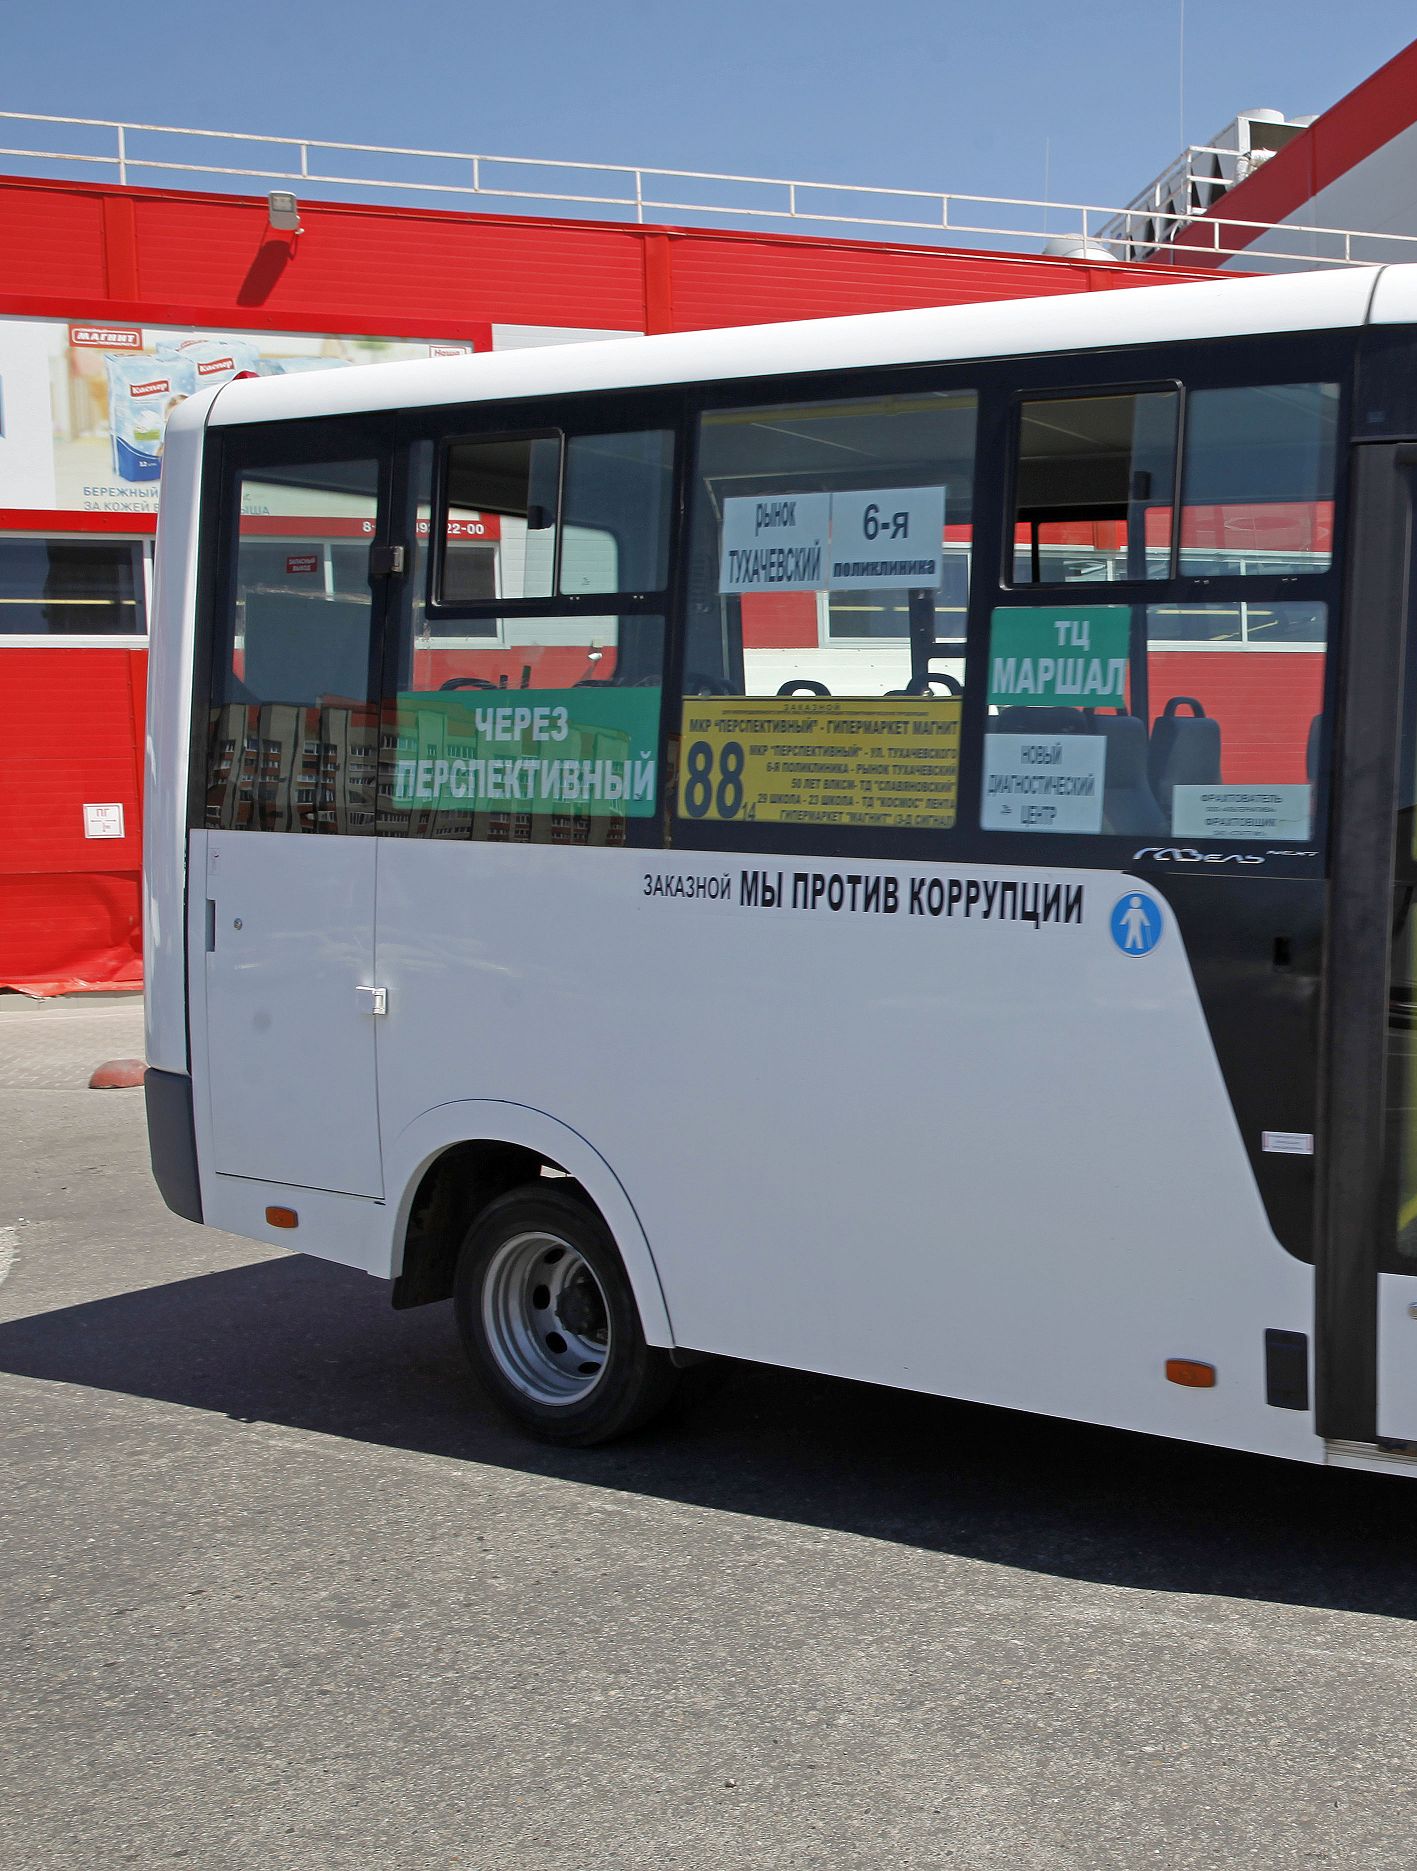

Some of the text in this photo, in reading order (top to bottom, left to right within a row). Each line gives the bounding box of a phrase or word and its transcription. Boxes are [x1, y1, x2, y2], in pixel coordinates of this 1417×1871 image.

[76, 331, 135, 344] МАГНИТ
[83, 486, 159, 498] БЕРЕЖНЫЙ
[84, 501, 101, 511] ЗА
[103, 502, 150, 513] КОЖЕЙ
[728, 540, 822, 583] ТУХАЧЕВСКИЙ
[833, 558, 936, 578] поликлиника
[1055, 620, 1090, 652] ТЦ
[991, 657, 1128, 696] МАРШАЛ
[475, 706, 569, 742] ЧЕРЕЗ
[827, 720, 910, 735] ГИПЕРМАРКЕТ
[1020, 742, 1063, 765] НОВЫЙ
[395, 750, 656, 801] ПЕРСПЕКТИВНЫЙ
[684, 740, 745, 819] 88
[987, 773, 1096, 797] ДИАГНОСТИЧЕСКИЙ
[1021, 805, 1057, 827] ЦЕНТР
[642, 870, 1086, 929] ЗАКАЗНОЙ МЫ ПРОТИВ КОРРУПЦИИ
